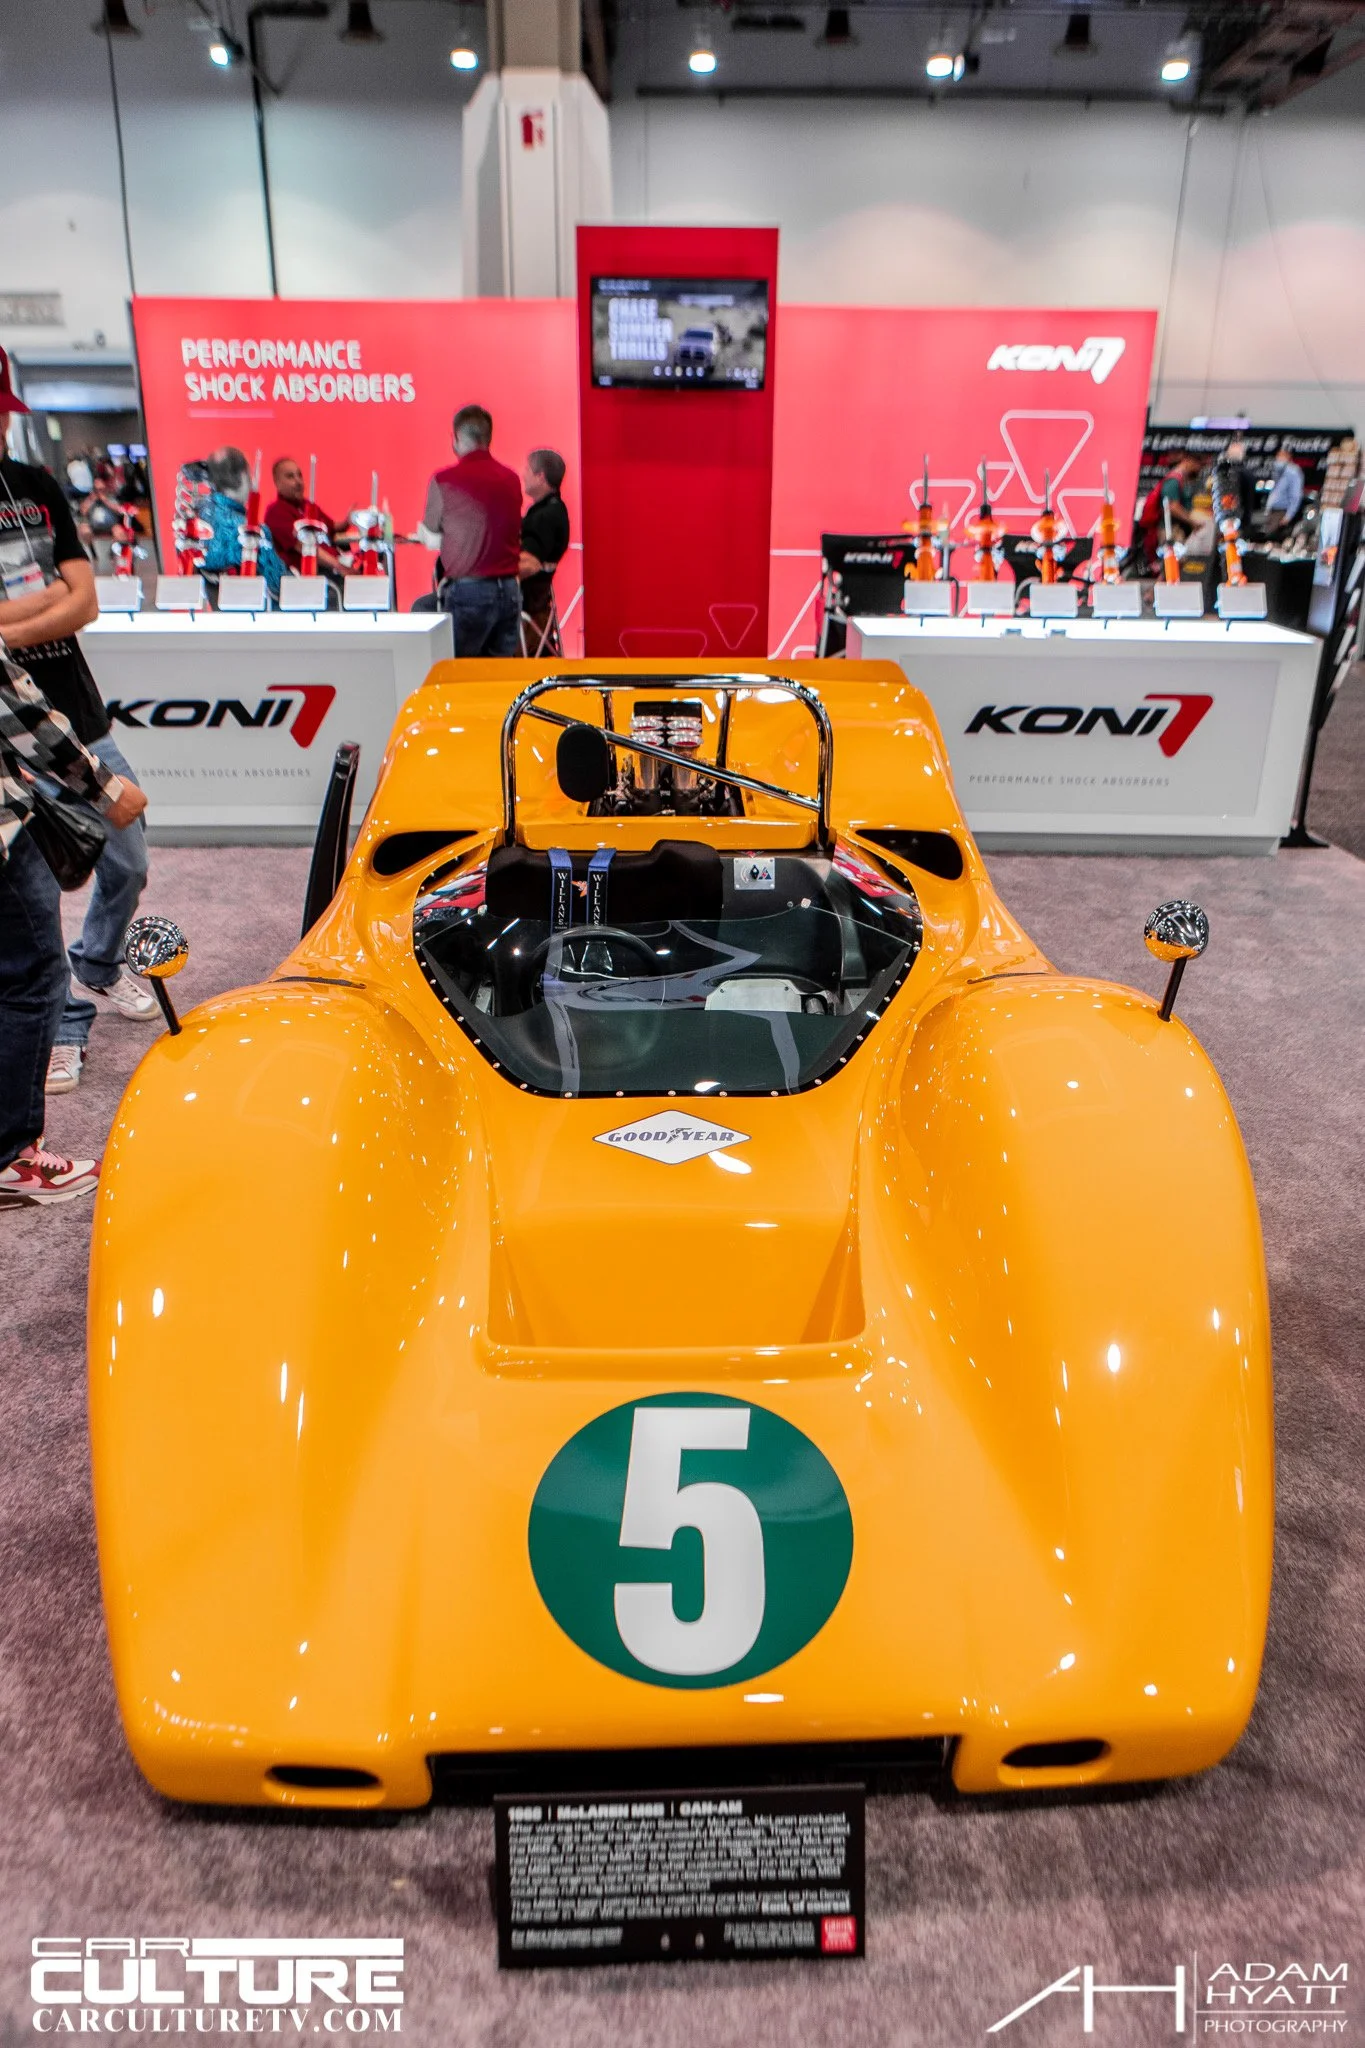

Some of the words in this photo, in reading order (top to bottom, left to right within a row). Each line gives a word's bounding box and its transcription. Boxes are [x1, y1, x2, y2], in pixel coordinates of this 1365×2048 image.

[181, 338, 362, 369] PERFORMANCE
[184, 372, 266, 402] SHOCK
[272, 373, 416, 402] ABSORBERS
[201, 768, 238, 778] SHOCK
[244, 769, 311, 778] ABSORBERS
[969, 774, 1053, 785] PERFORMANCE
[1059, 776, 1096, 786] SHOCK
[1102, 776, 1170, 787] ABSORBERS
[557, 872, 568, 926] WILLANS
[592, 874, 603, 927] WILLANS
[613, 1407, 766, 1676] 5
